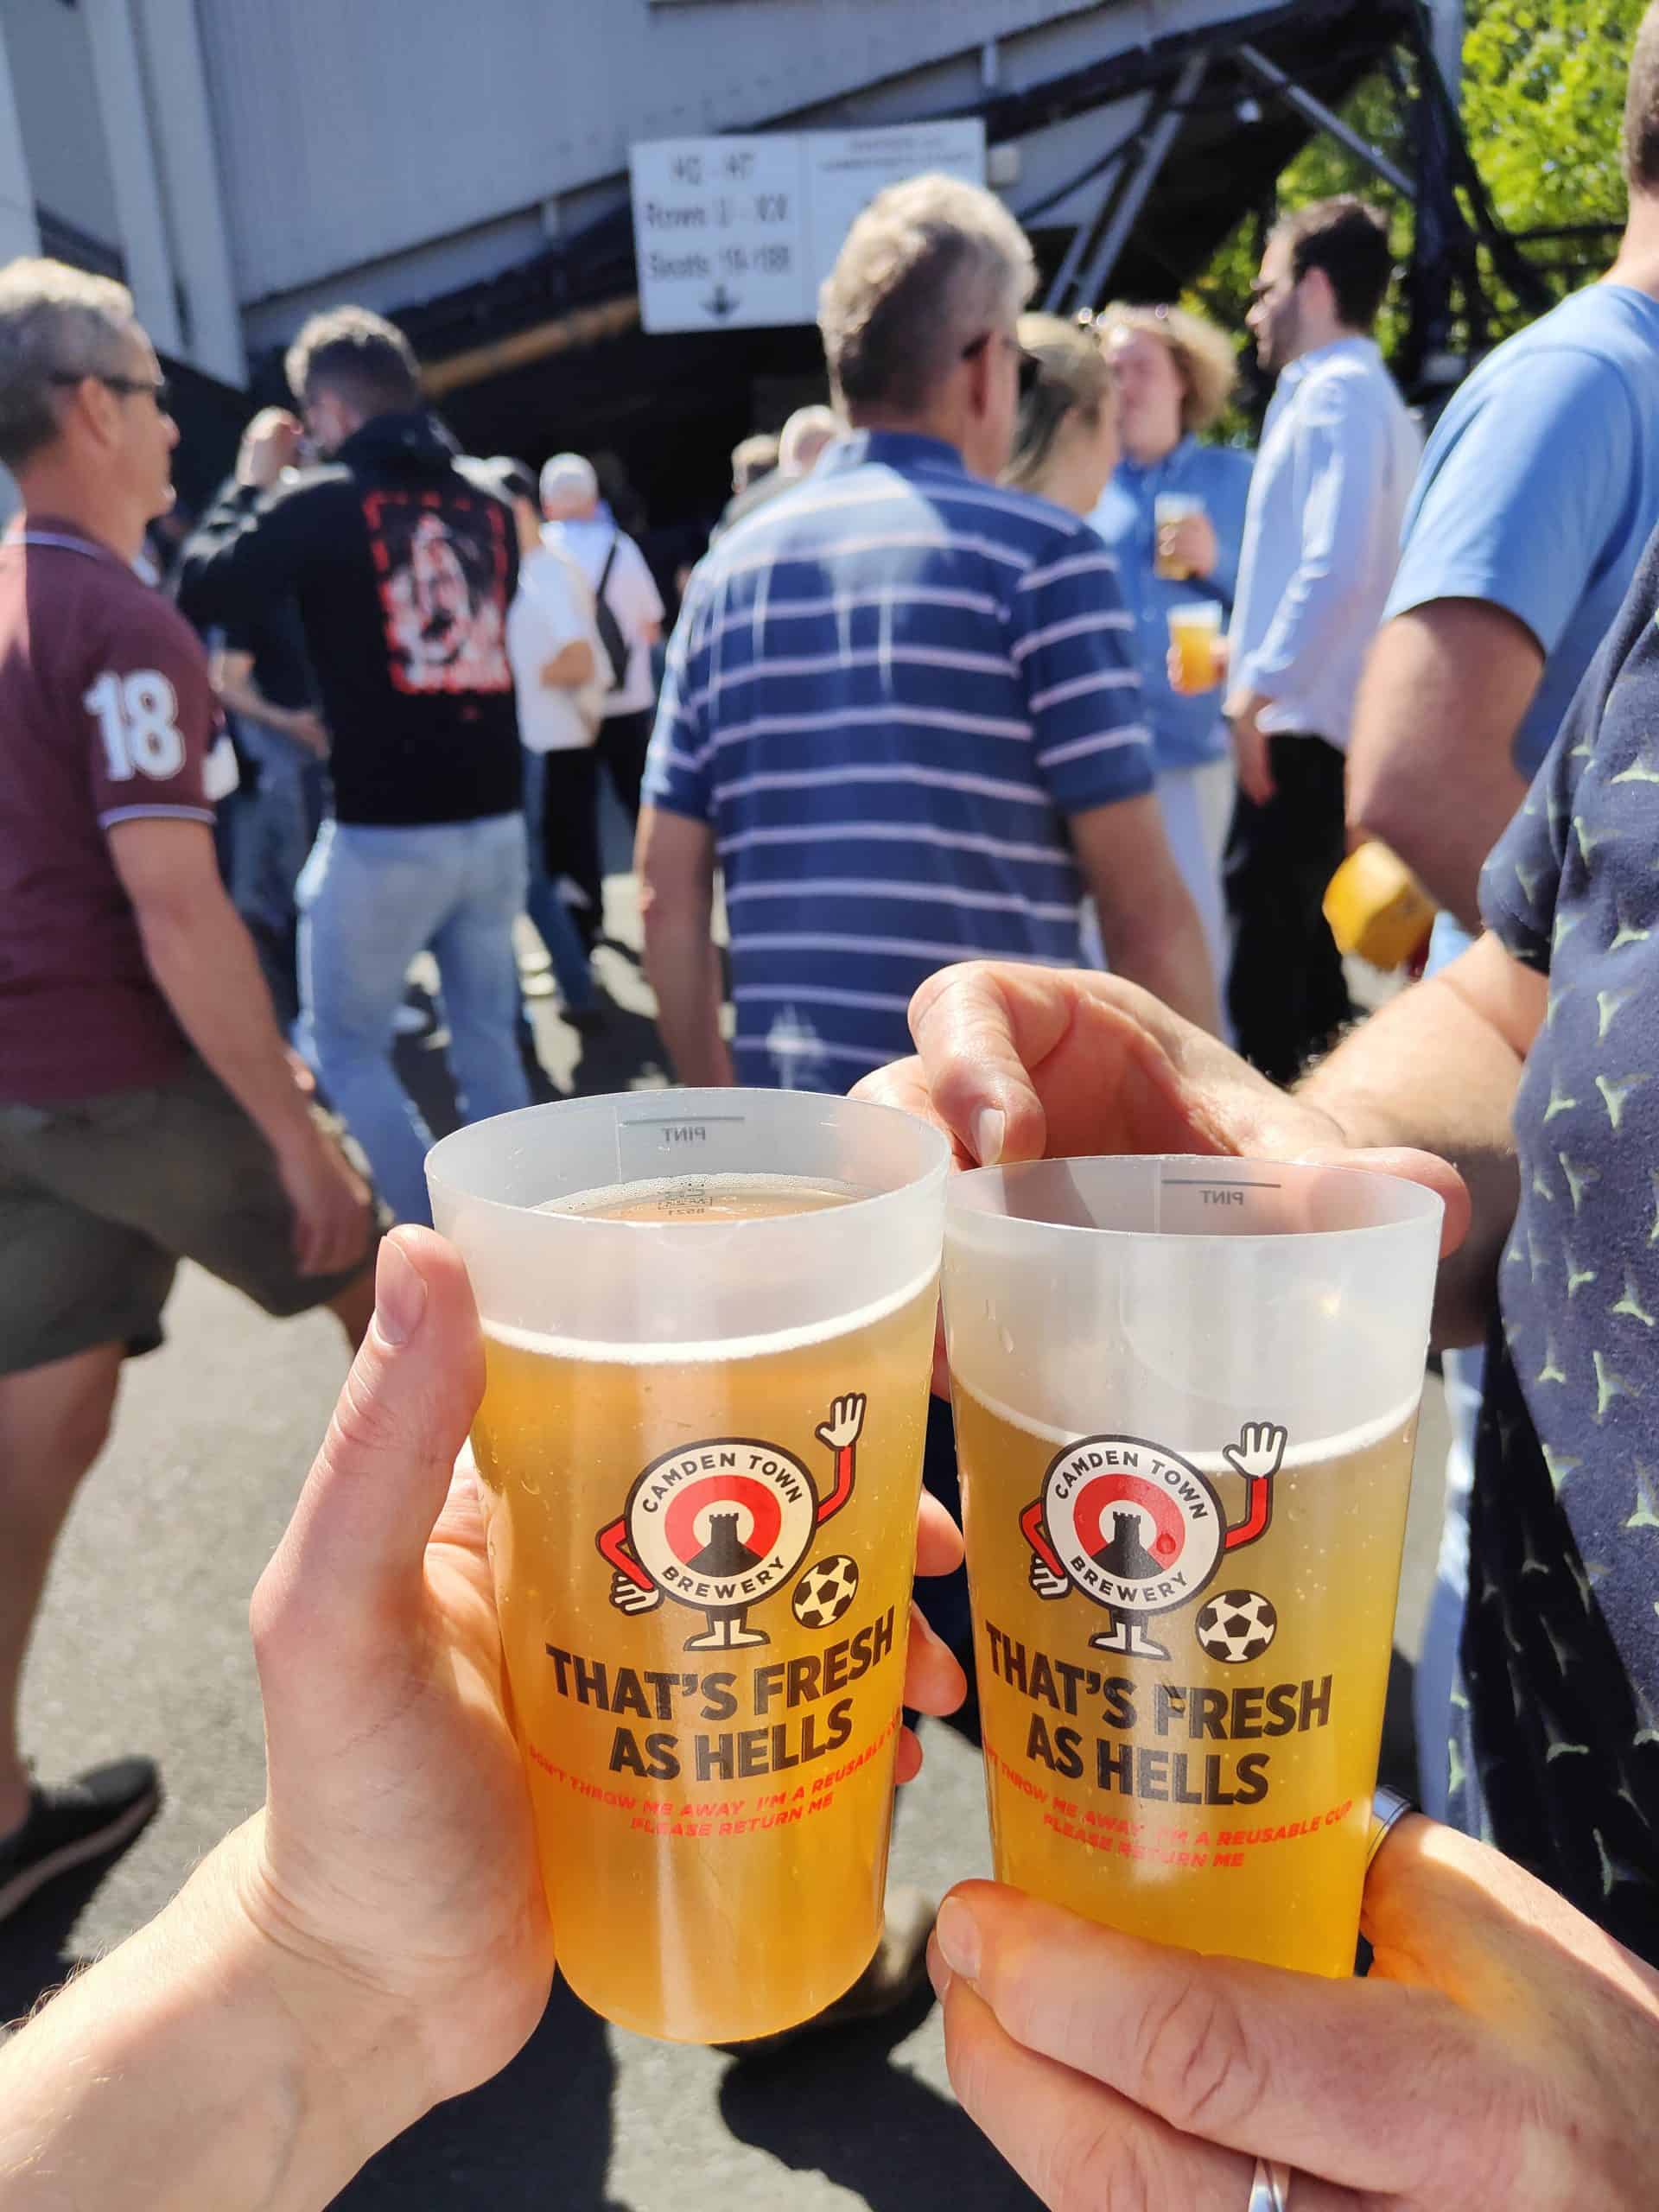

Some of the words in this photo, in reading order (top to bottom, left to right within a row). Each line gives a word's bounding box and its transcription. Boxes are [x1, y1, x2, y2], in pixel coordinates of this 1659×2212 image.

[83, 669, 185, 780] 18
[642, 1452, 735, 1513] CAMDEN
[749, 1454, 803, 1503] TOWN
[1055, 1450, 1139, 1499] CAMDEN
[1151, 1459, 1208, 1519] TOWN
[662, 1555, 785, 1599] BREWERY
[1070, 1555, 1188, 1602] BREWERY
[545, 1643, 738, 1721] THAT'S
[753, 1606, 894, 1716] FRESH
[985, 1619, 1138, 1730] THAT'S
[1154, 1674, 1333, 1740] FRESH
[609, 1726, 680, 1780] AS
[696, 1697, 854, 1782] HELLS
[1027, 1712, 1083, 1779] AS
[1096, 1737, 1271, 1805] HELLS
[570, 1776, 636, 1809] THROW
[643, 1798, 673, 1815] ME
[680, 1800, 745, 1818] AWAY
[756, 1791, 786, 1813] I'M
[792, 1785, 804, 1802] A
[630, 1817, 712, 1837] PLEASE
[719, 1805, 803, 1837] RETURN
[809, 1792, 834, 1815] ME
[1052, 1796, 1078, 1818] ME
[1084, 1810, 1142, 1837] AWAY
[1196, 1830, 1210, 1846] A
[1216, 1815, 1321, 1847] REUSABLE
[1043, 1812, 1113, 1852] PLEASE
[1212, 1853, 1244, 1868] ME
